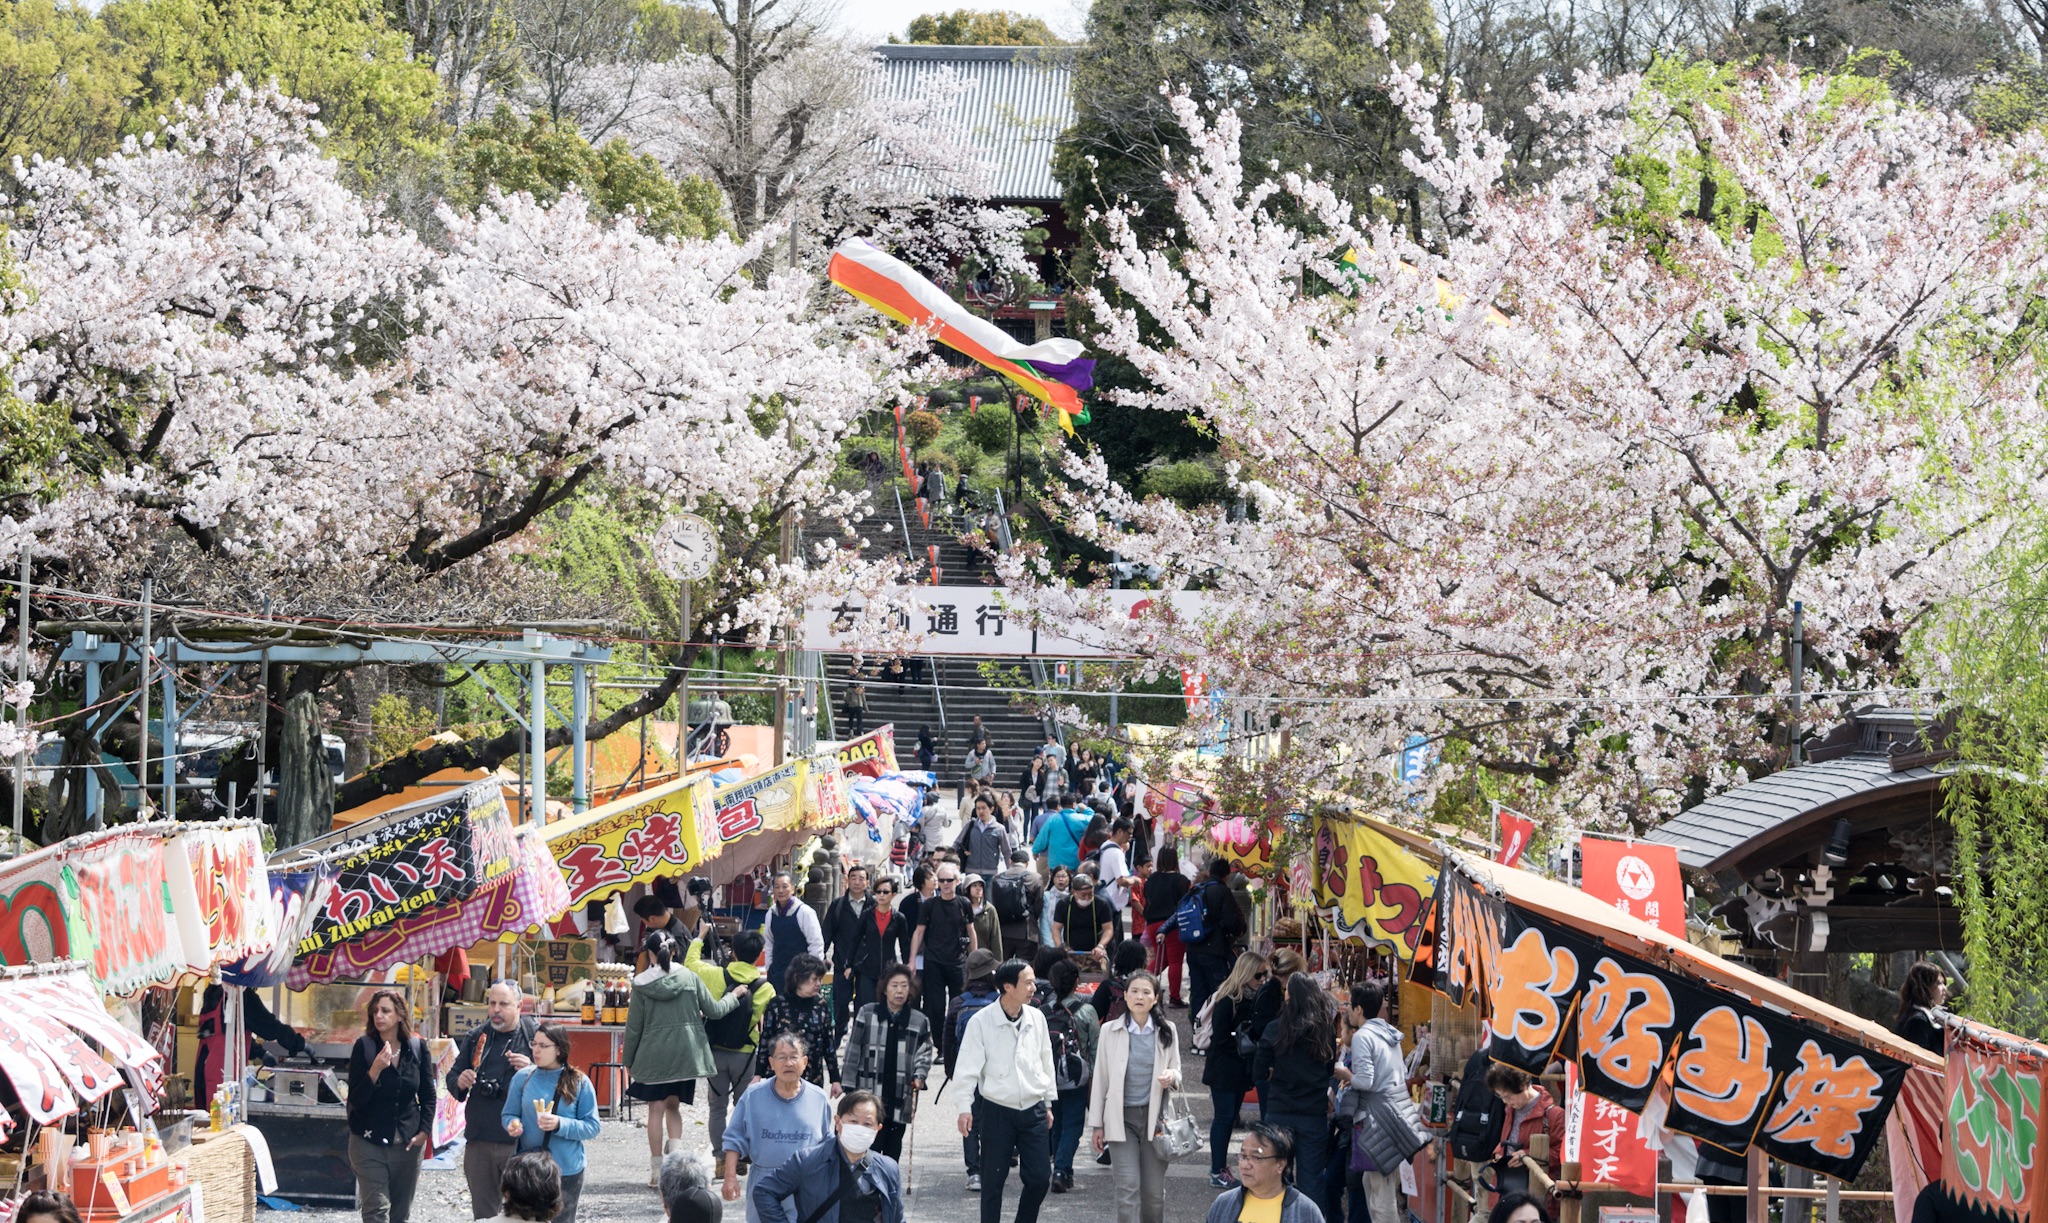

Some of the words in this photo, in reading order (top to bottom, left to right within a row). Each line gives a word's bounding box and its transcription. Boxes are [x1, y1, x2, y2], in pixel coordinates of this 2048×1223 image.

[682, 521, 692, 531] 12
[702, 532, 709, 541] 2
[705, 542, 712, 552] 3
[701, 553, 708, 563] 4
[672, 562, 679, 571] 7
[693, 562, 700, 571] 5
[318, 837, 466, 930] わい天
[761, 1128, 812, 1141] Budweiser
